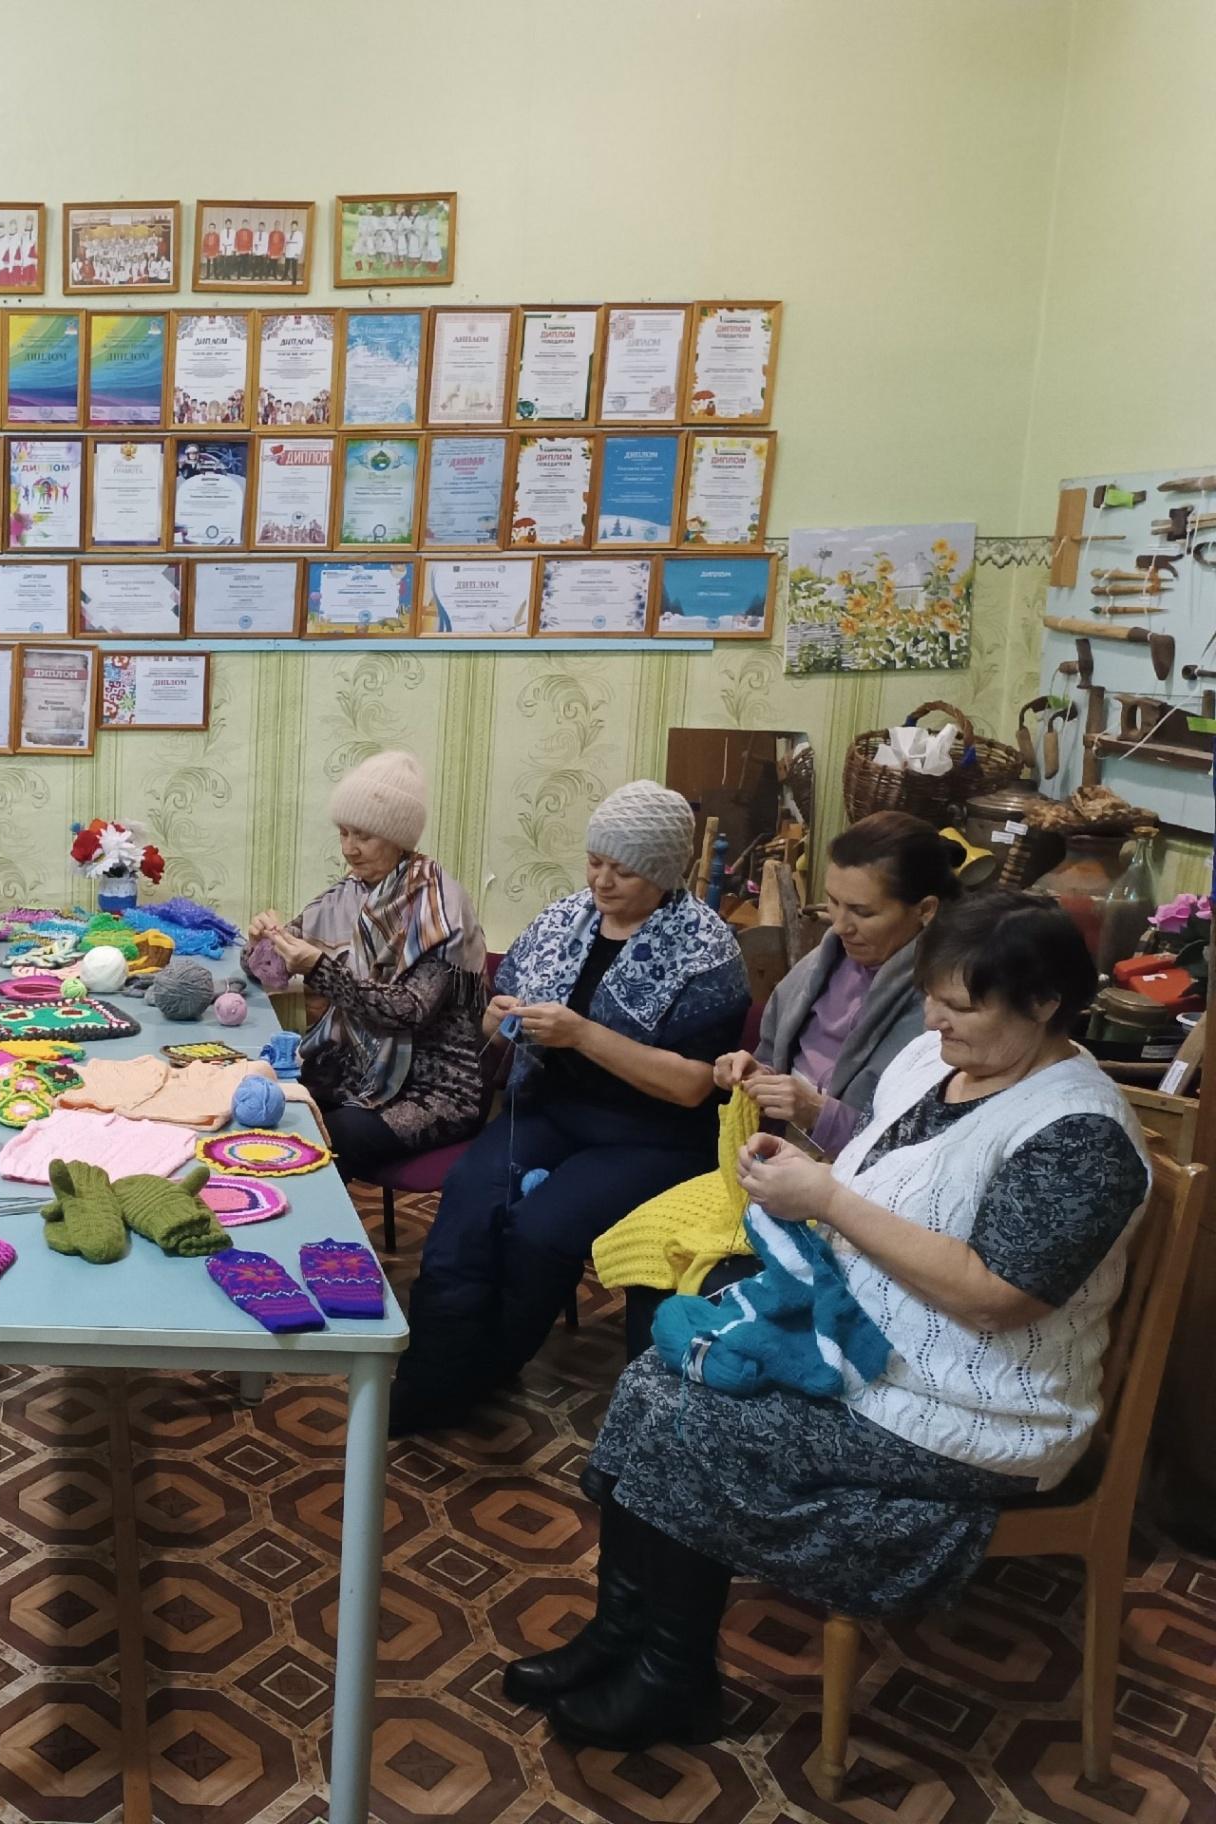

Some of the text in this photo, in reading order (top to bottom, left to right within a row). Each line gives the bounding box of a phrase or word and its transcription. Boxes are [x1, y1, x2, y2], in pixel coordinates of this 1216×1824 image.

[715, 325, 752, 333] ДИПЛОМ
[540, 330, 576, 339] ДИПЛОМ
[194, 338, 228, 346] ДИПЛОМ
[279, 338, 315, 347] ДИПЛОМ
[24, 352, 67, 362] ДИПЛОМ
[107, 352, 151, 362] ДИПЛОМ
[286, 451, 330, 465] ДИПЛОМ
[536, 453, 573, 462] ДИПЛОМ
[710, 456, 747, 464] ДИПЛОМ
[21, 464, 71, 472] ДИПЛОМ
[34, 669, 79, 679] ДИПЛОМ
